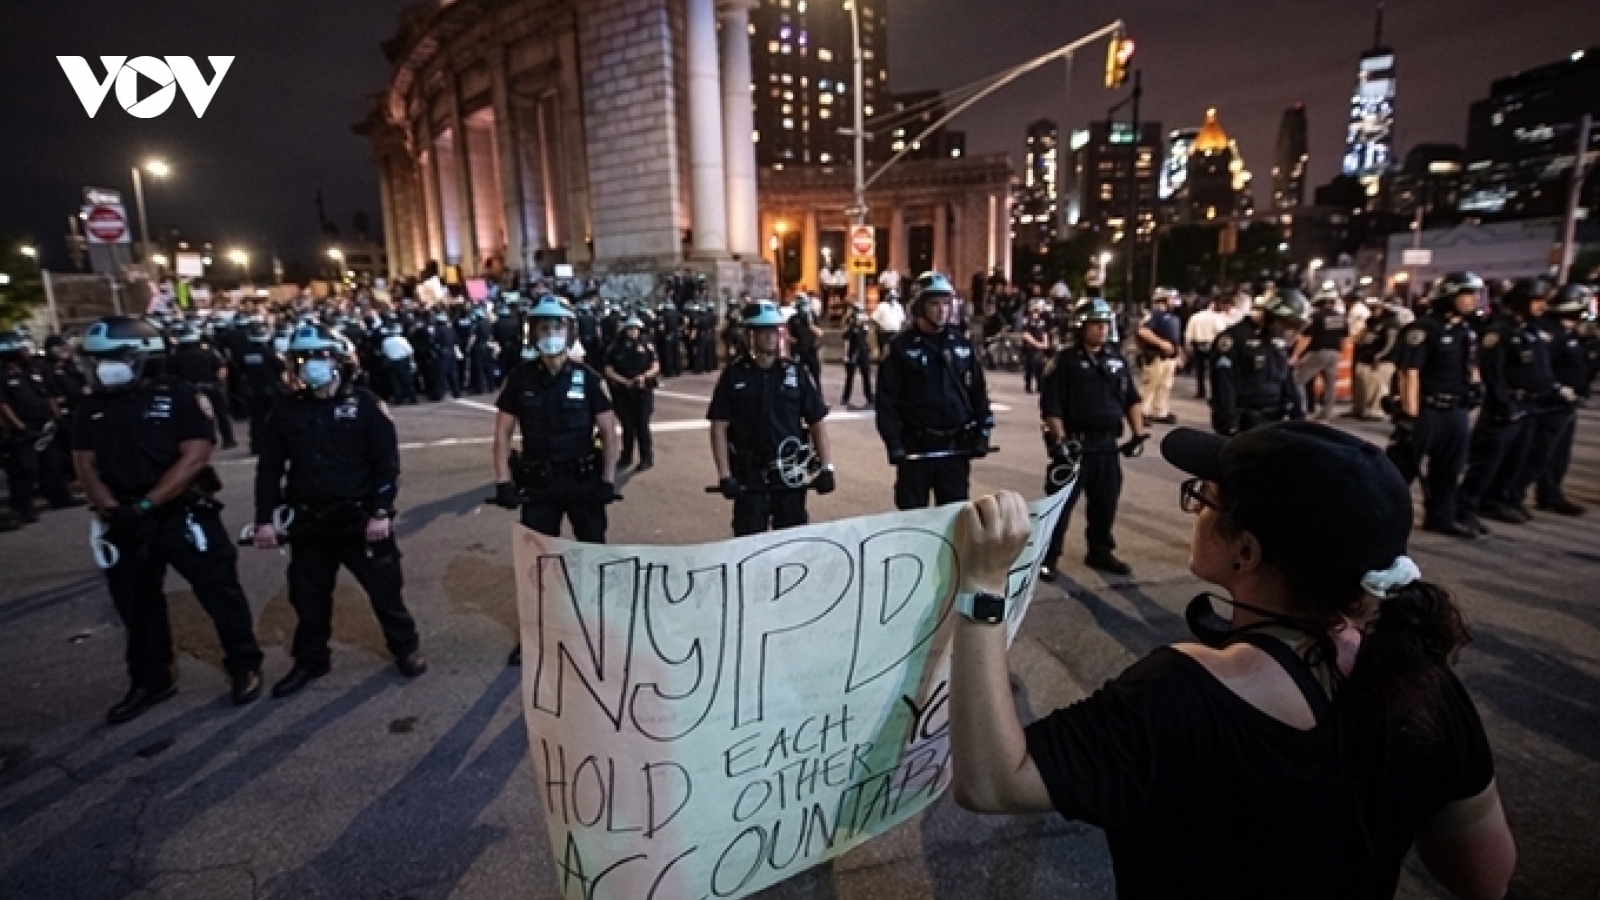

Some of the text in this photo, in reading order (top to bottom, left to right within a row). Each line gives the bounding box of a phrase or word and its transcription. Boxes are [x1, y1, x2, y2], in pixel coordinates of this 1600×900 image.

[723, 704, 854, 777] EACH
[541, 738, 692, 839] HOLD
[732, 742, 874, 822] OTHER
